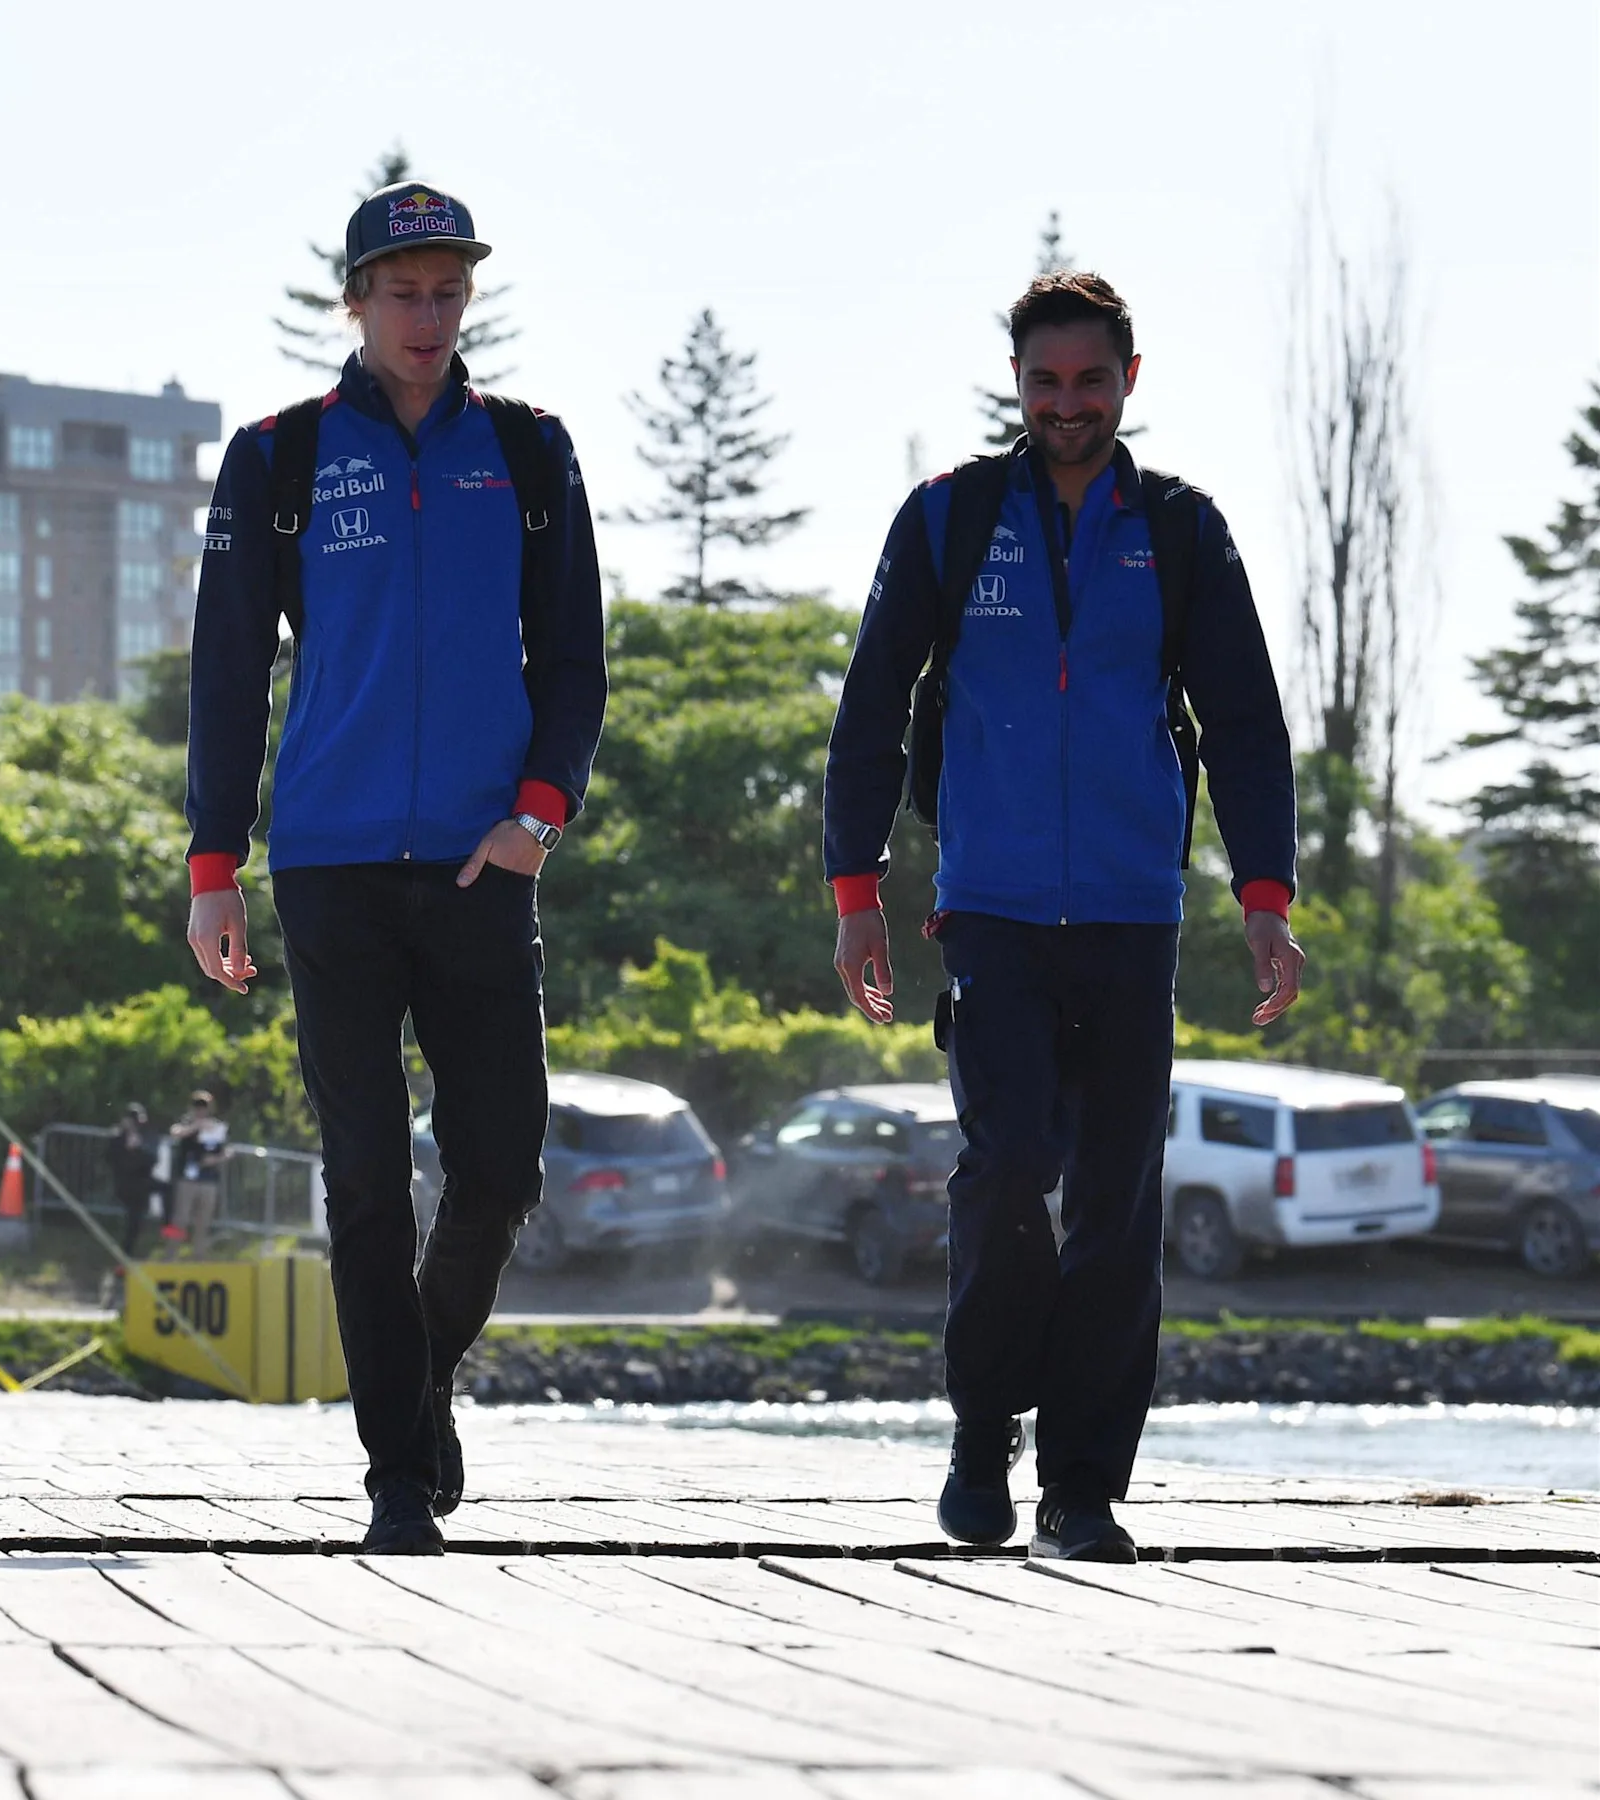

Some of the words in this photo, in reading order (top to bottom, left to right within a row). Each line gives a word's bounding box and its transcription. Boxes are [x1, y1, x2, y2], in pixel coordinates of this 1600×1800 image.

[389, 216, 424, 236] Red
[425, 216, 456, 234] Bull
[458, 478, 482, 489] Toro
[568, 470, 582, 487] Re
[312, 480, 346, 504] Red
[347, 473, 385, 496] Bull
[208, 506, 232, 520] onis
[204, 540, 231, 551] ELLI
[322, 535, 388, 553] HONDA
[989, 545, 1024, 563] Bull
[1225, 546, 1239, 563] Re
[964, 607, 1023, 616] HONDA
[154, 1281, 228, 1336] 500
